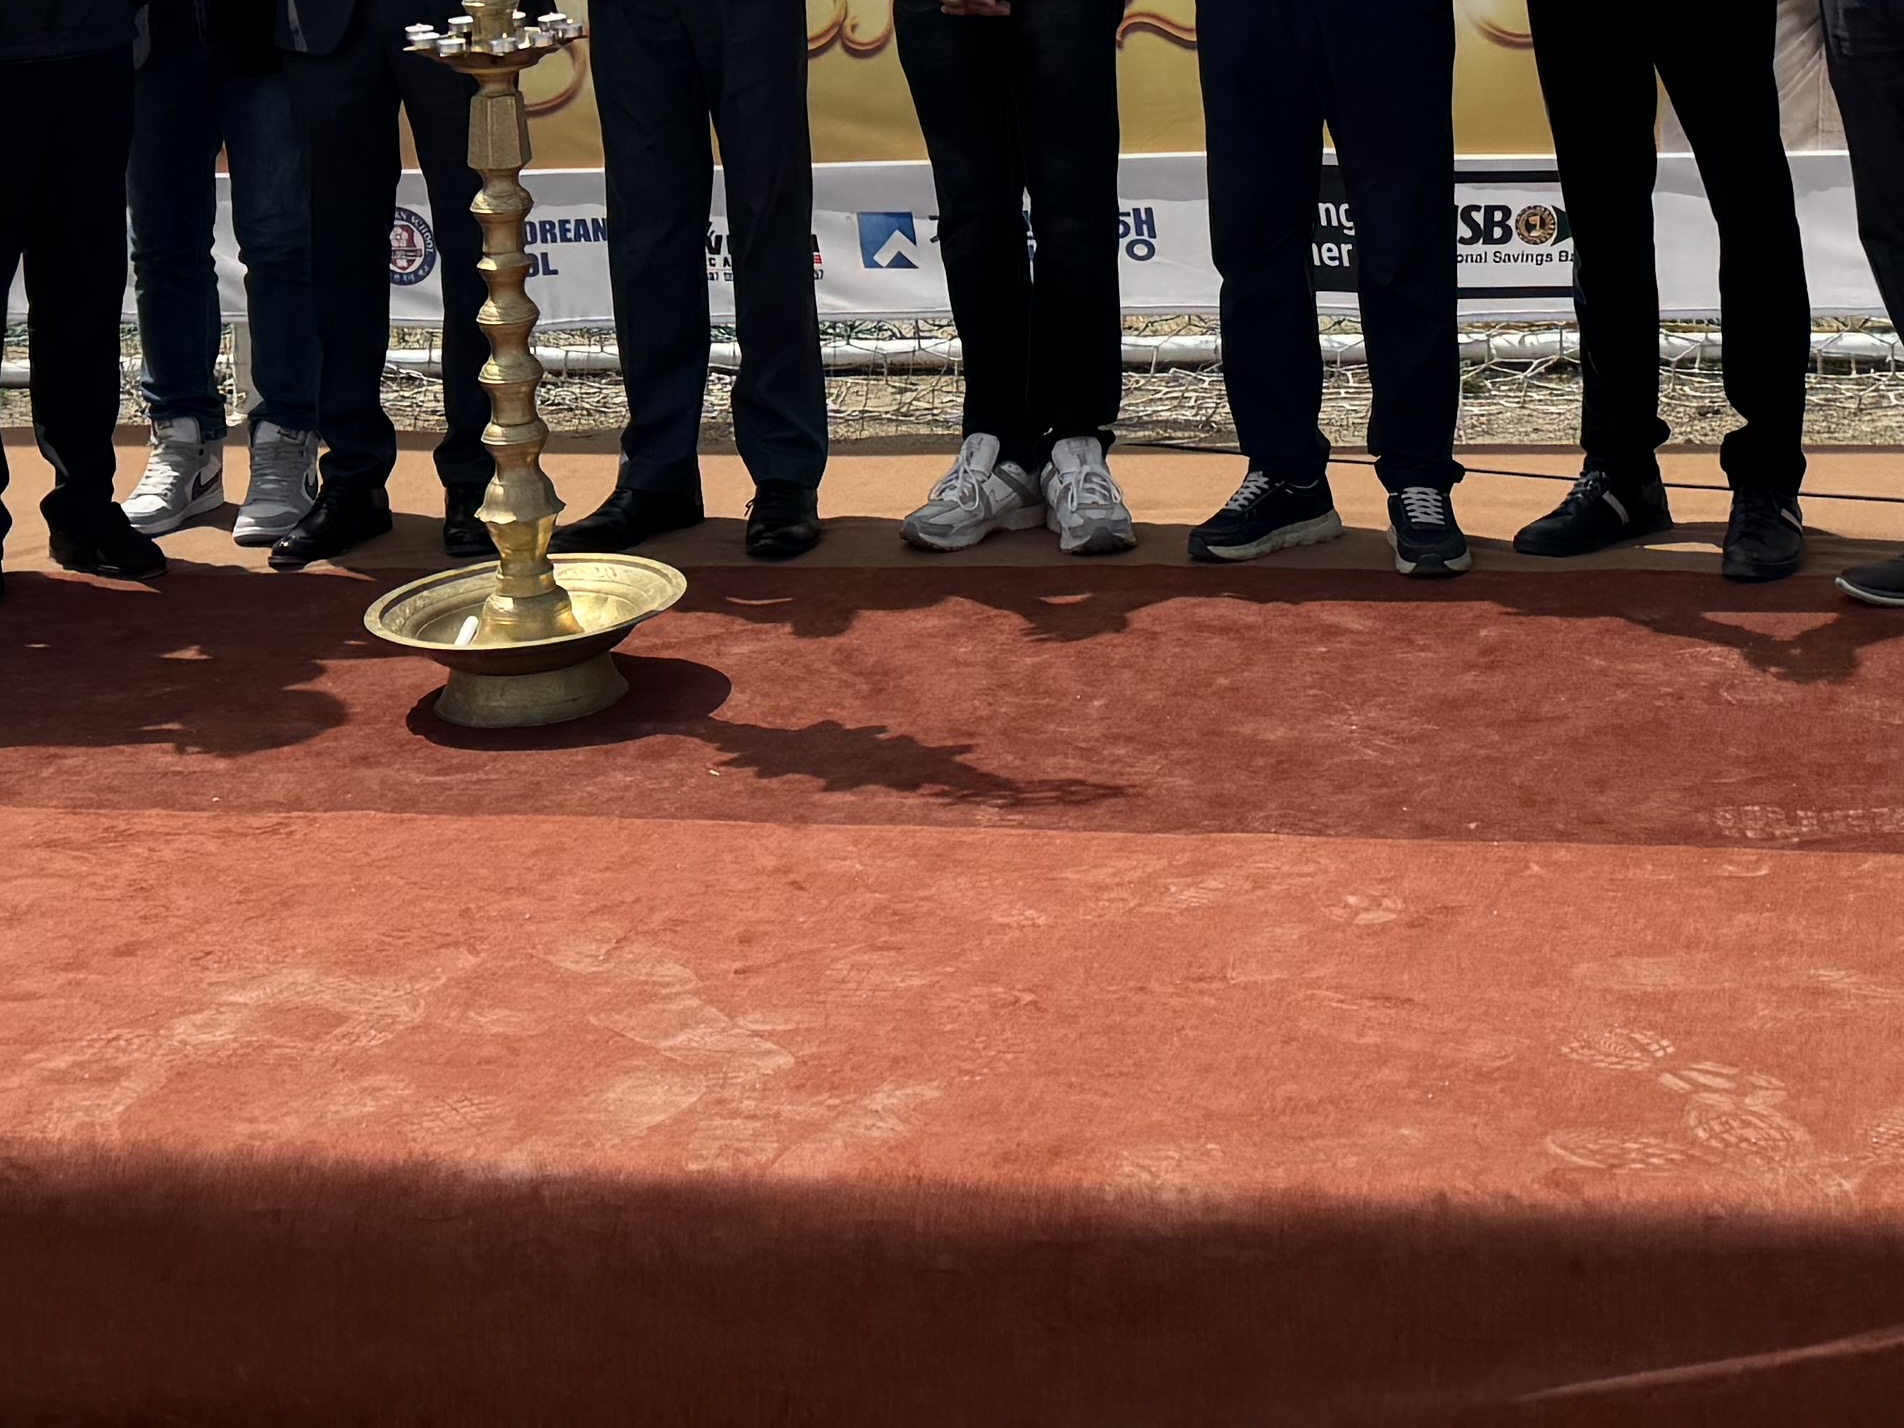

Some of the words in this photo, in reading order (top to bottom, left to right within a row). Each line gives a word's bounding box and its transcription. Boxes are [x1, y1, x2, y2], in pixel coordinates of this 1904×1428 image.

[521, 217, 608, 245] OREAN
[1457, 203, 1513, 246] SB
[1456, 250, 1488, 264] onal
[1492, 249, 1554, 267] Savings
